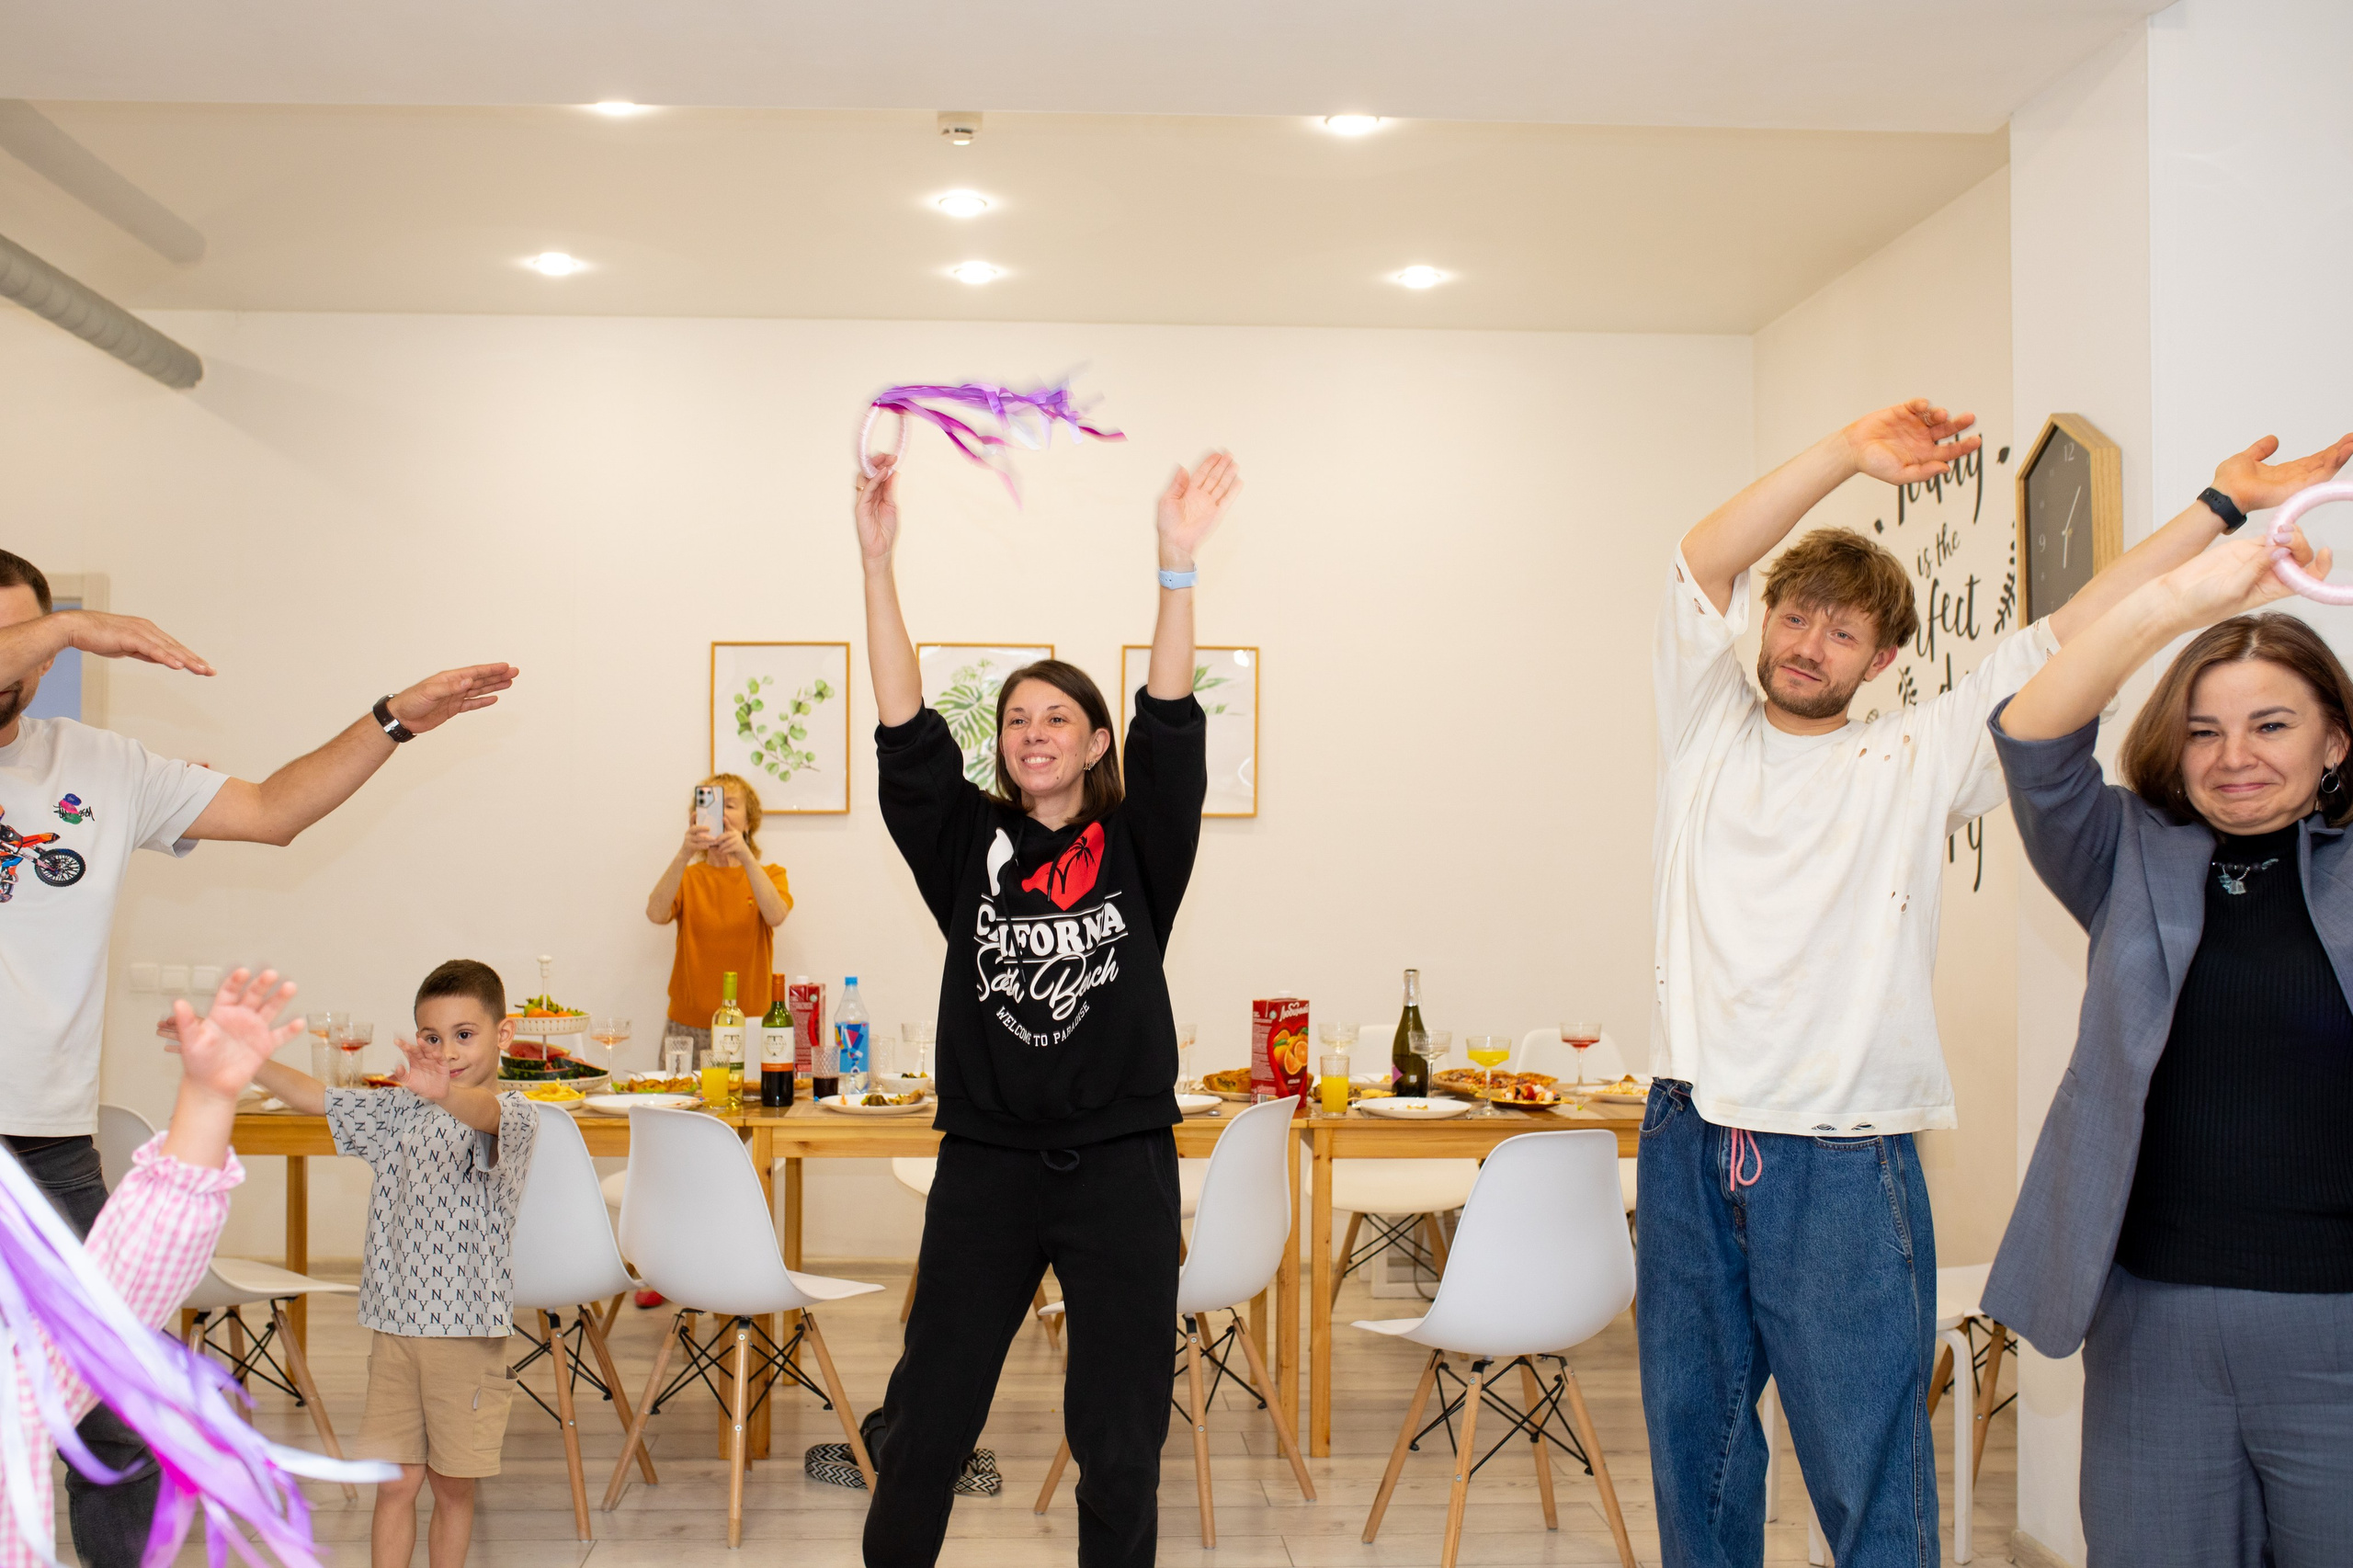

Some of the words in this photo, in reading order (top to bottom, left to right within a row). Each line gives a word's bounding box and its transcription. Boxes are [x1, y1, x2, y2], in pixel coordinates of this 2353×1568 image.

[2063, 442, 2075, 461] 12
[1916, 548, 1932, 579] is
[1936, 522, 1961, 567] the
[2039, 533, 2046, 552] 9
[995, 1006, 1032, 1046] WELCOME
[1033, 1033, 1049, 1047] TO
[1053, 1000, 1090, 1045] PARADISE
